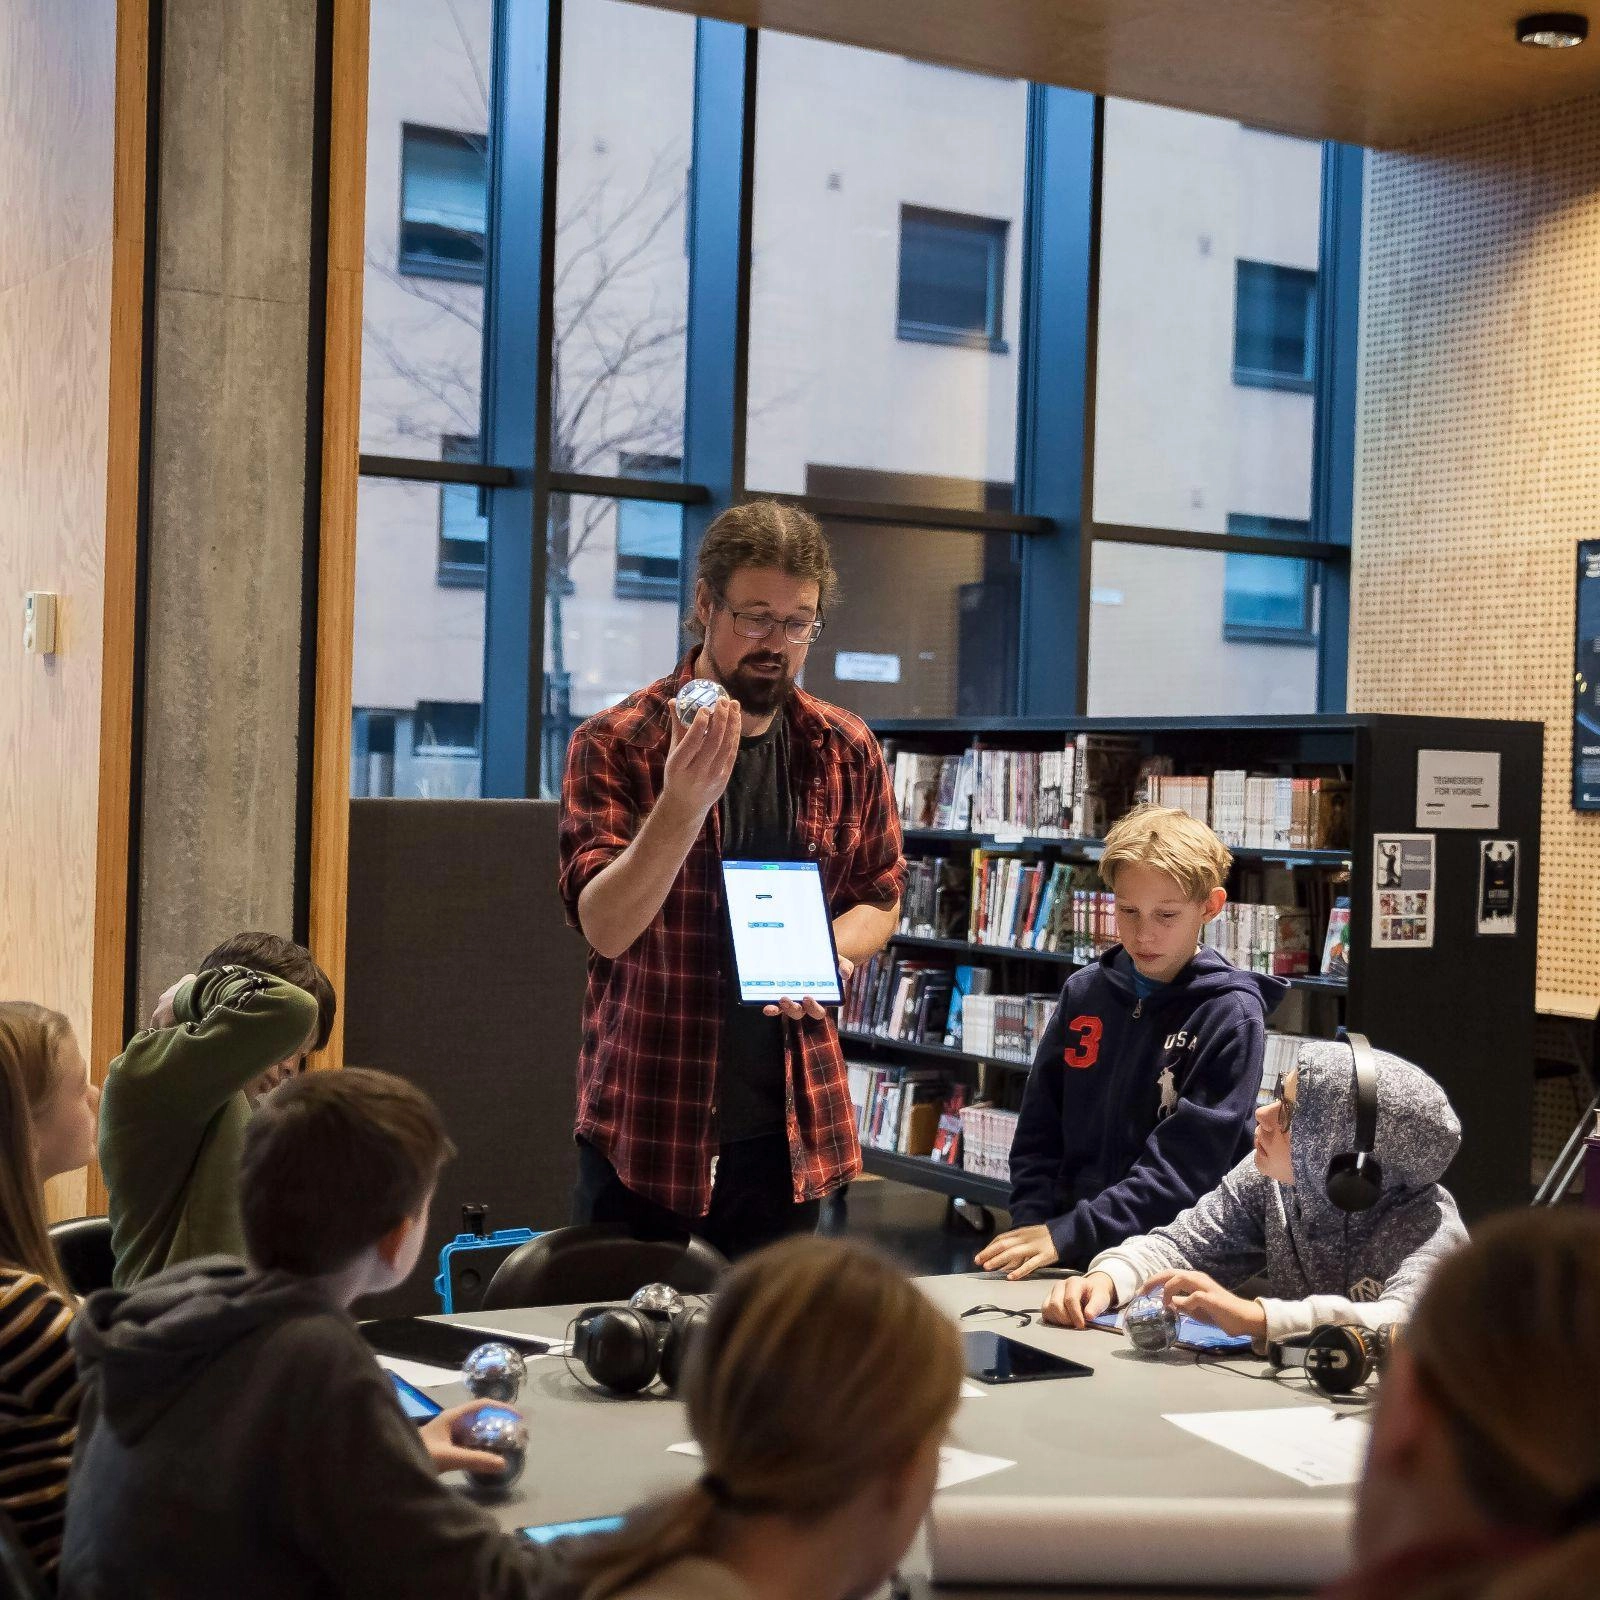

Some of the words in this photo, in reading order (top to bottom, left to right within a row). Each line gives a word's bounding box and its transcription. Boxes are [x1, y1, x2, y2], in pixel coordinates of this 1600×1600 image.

[1434, 787, 1450, 795] FOR
[1064, 1015, 1104, 1069] 3
[1164, 1031, 1198, 1051] USA
